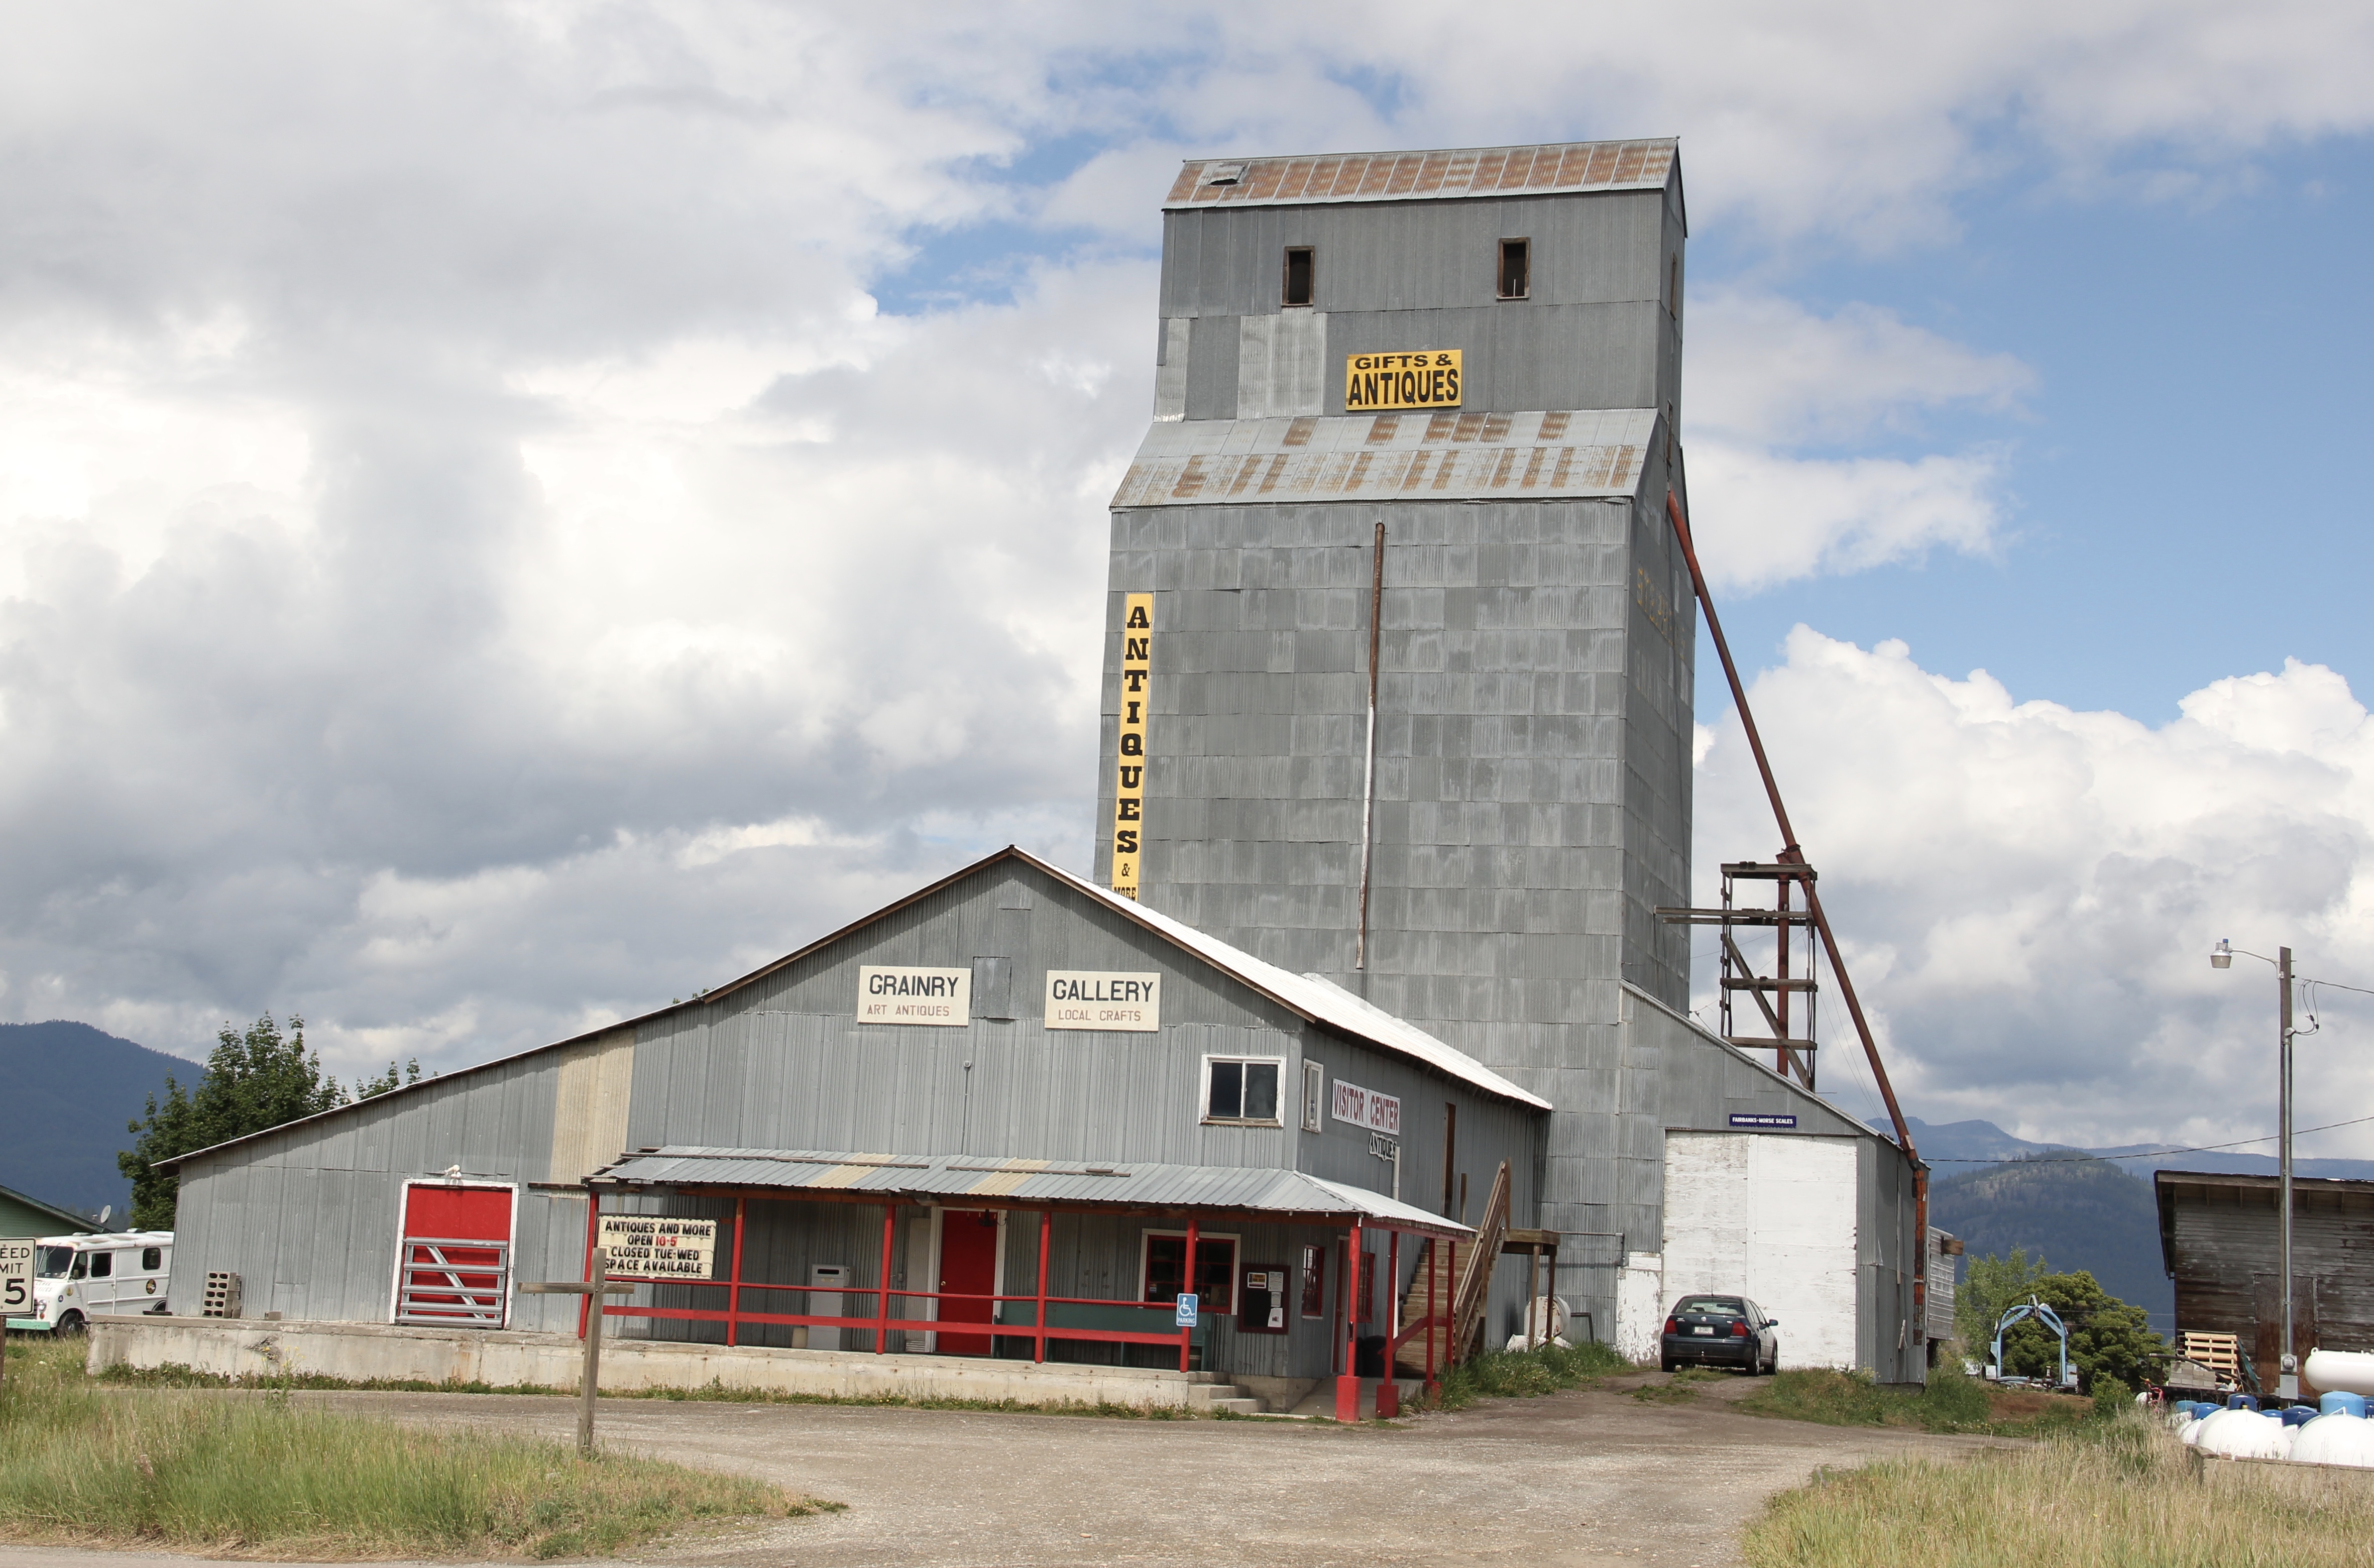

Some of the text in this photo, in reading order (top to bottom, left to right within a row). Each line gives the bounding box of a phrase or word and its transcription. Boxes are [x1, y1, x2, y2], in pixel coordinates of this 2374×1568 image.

[1355, 354, 1452, 370] GIFTS &
[1348, 369, 1458, 405] ANTIQUES
[1117, 606, 1150, 853] ANTIQUES
[1121, 863, 1131, 877] &
[869, 974, 959, 997] GRAINRY
[1053, 979, 1154, 1002] GALLERY
[867, 1004, 950, 1016] ART ANTIQUES
[1058, 1010, 1141, 1022] LOCAL CRAFTS
[1334, 1083, 1399, 1131] VISITOR CENTER
[605, 1221, 711, 1236] ANTIQUES AND MORE
[627, 1235, 677, 1247] OPEN 10-5
[611, 1247, 700, 1261] CLOSED TUE-WED
[605, 1259, 703, 1273] SPACE AVAILABLE
